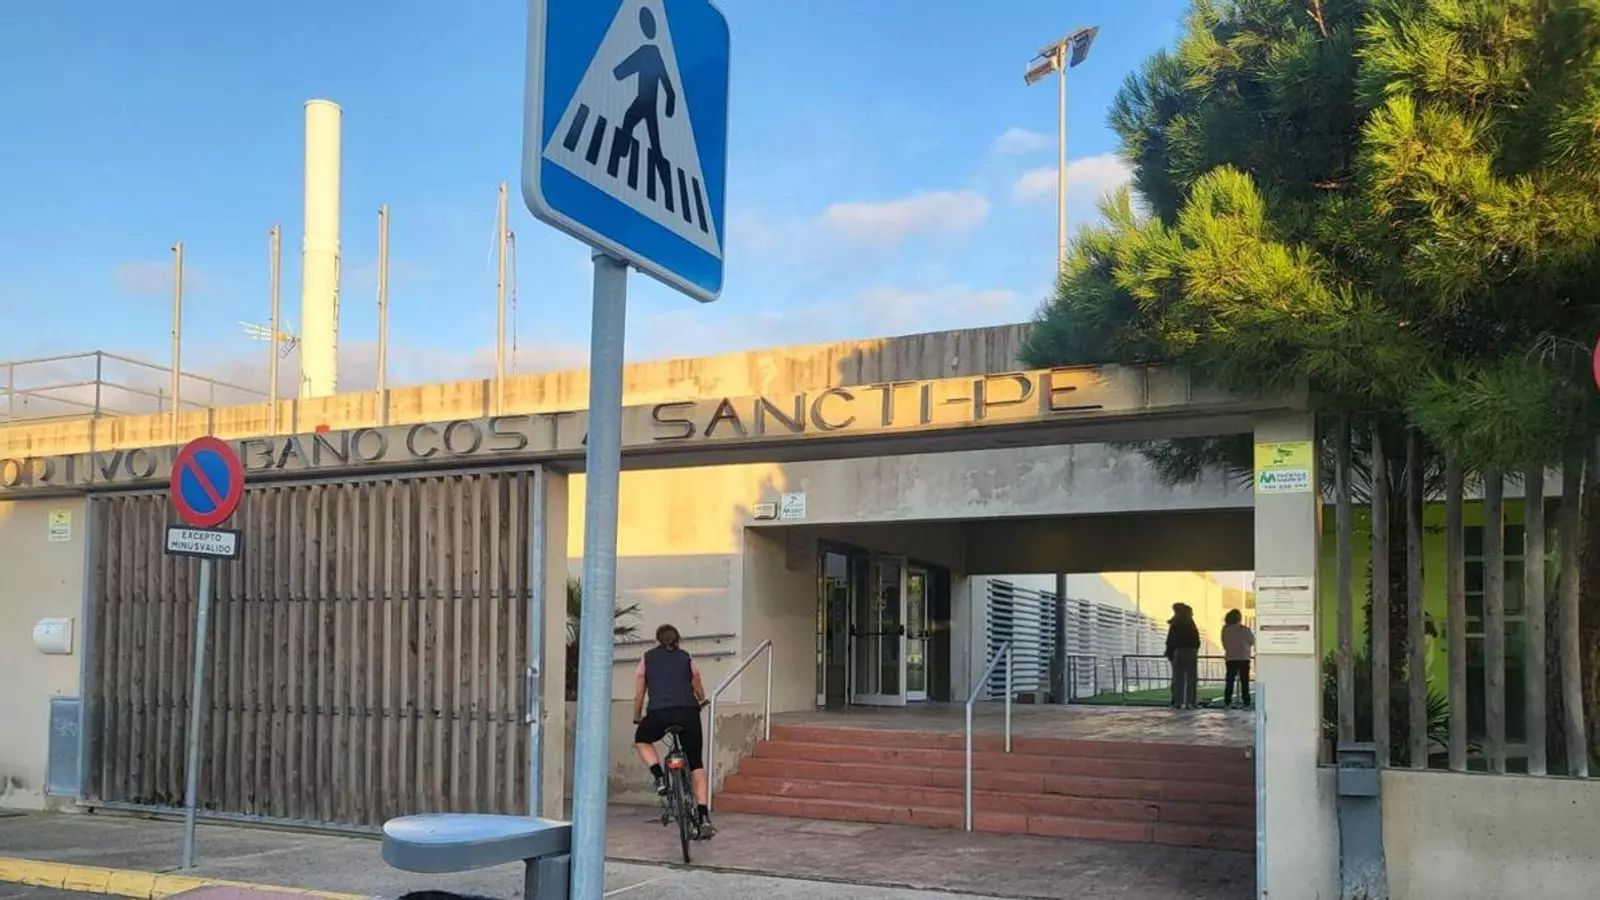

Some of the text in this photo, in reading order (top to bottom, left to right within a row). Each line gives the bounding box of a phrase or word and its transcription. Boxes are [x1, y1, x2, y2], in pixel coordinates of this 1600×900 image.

[163, 428, 386, 474] BANO
[407, 412, 589, 457] COST
[182, 531, 222, 541] EXCEPTO
[171, 541, 231, 553] MINUSVALIDO
